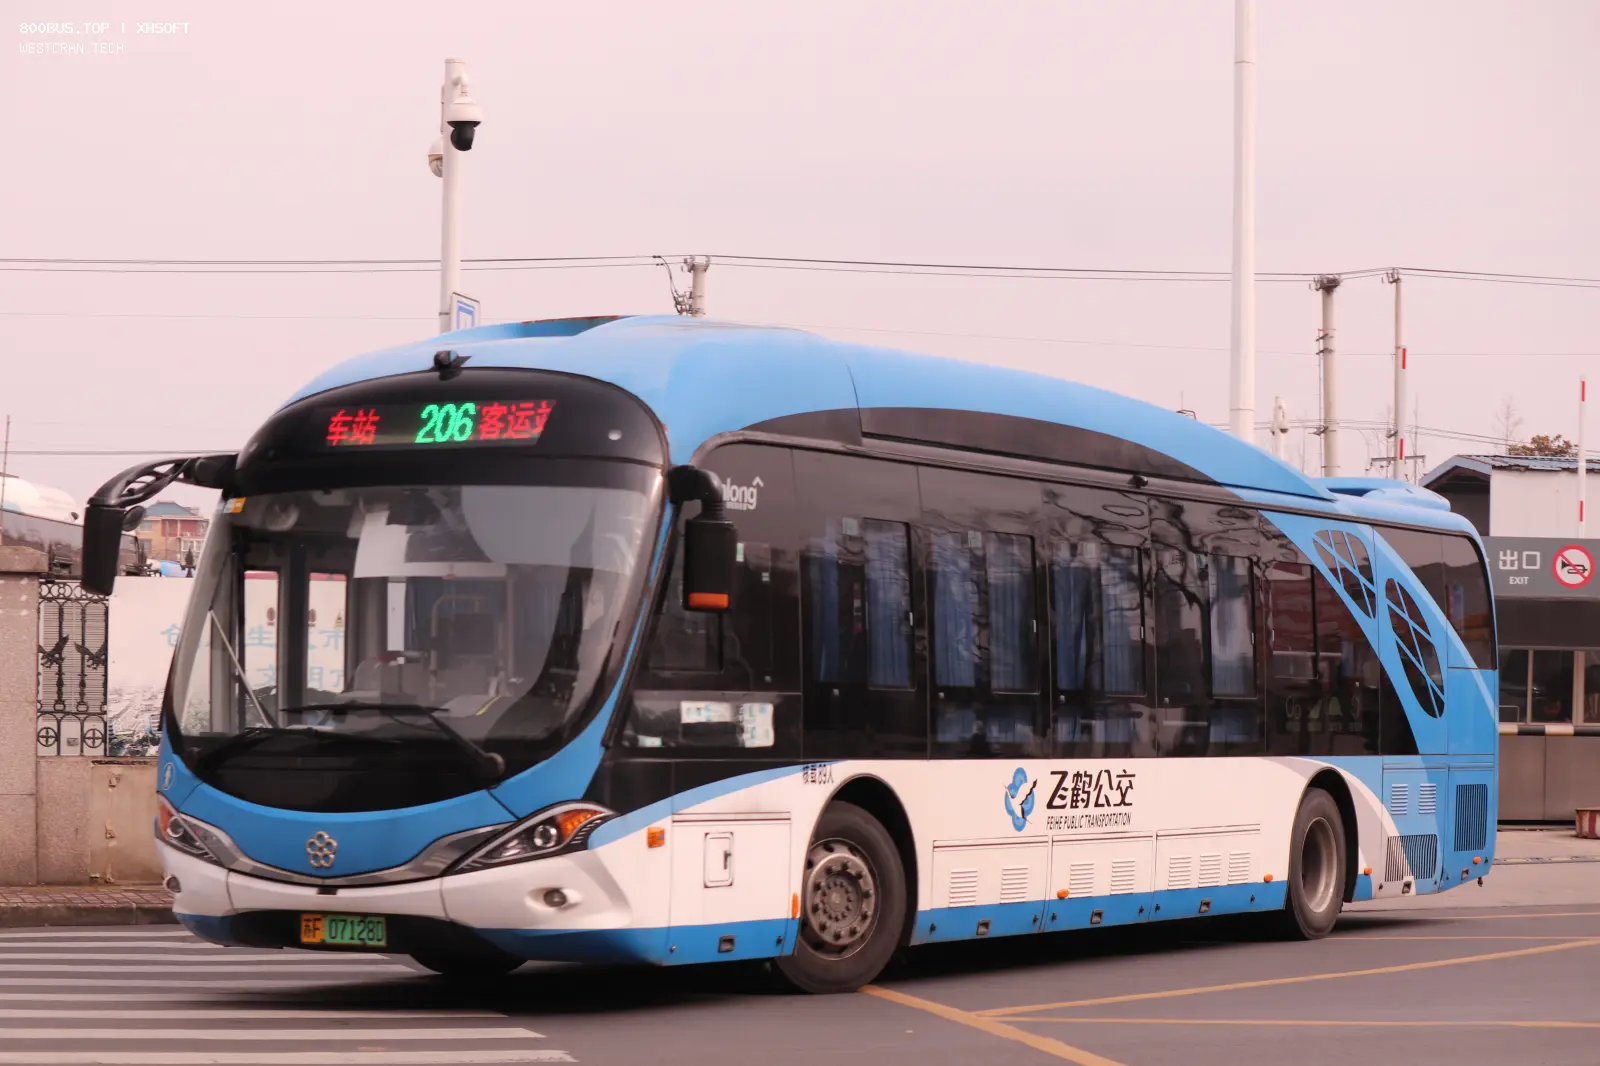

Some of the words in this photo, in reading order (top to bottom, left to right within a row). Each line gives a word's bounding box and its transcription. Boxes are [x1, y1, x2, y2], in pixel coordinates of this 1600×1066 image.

[326, 408, 380, 446] 车站
[414, 402, 477, 443] 206
[1498, 549, 1541, 570] 出口
[1509, 576, 1529, 585] EXIT
[1046, 769, 1136, 810] 飞鹤公交
[1046, 816, 1063, 830] FEIHE
[1063, 814, 1084, 829] PUBLIC
[1084, 812, 1132, 828] TRANSPORTATION
